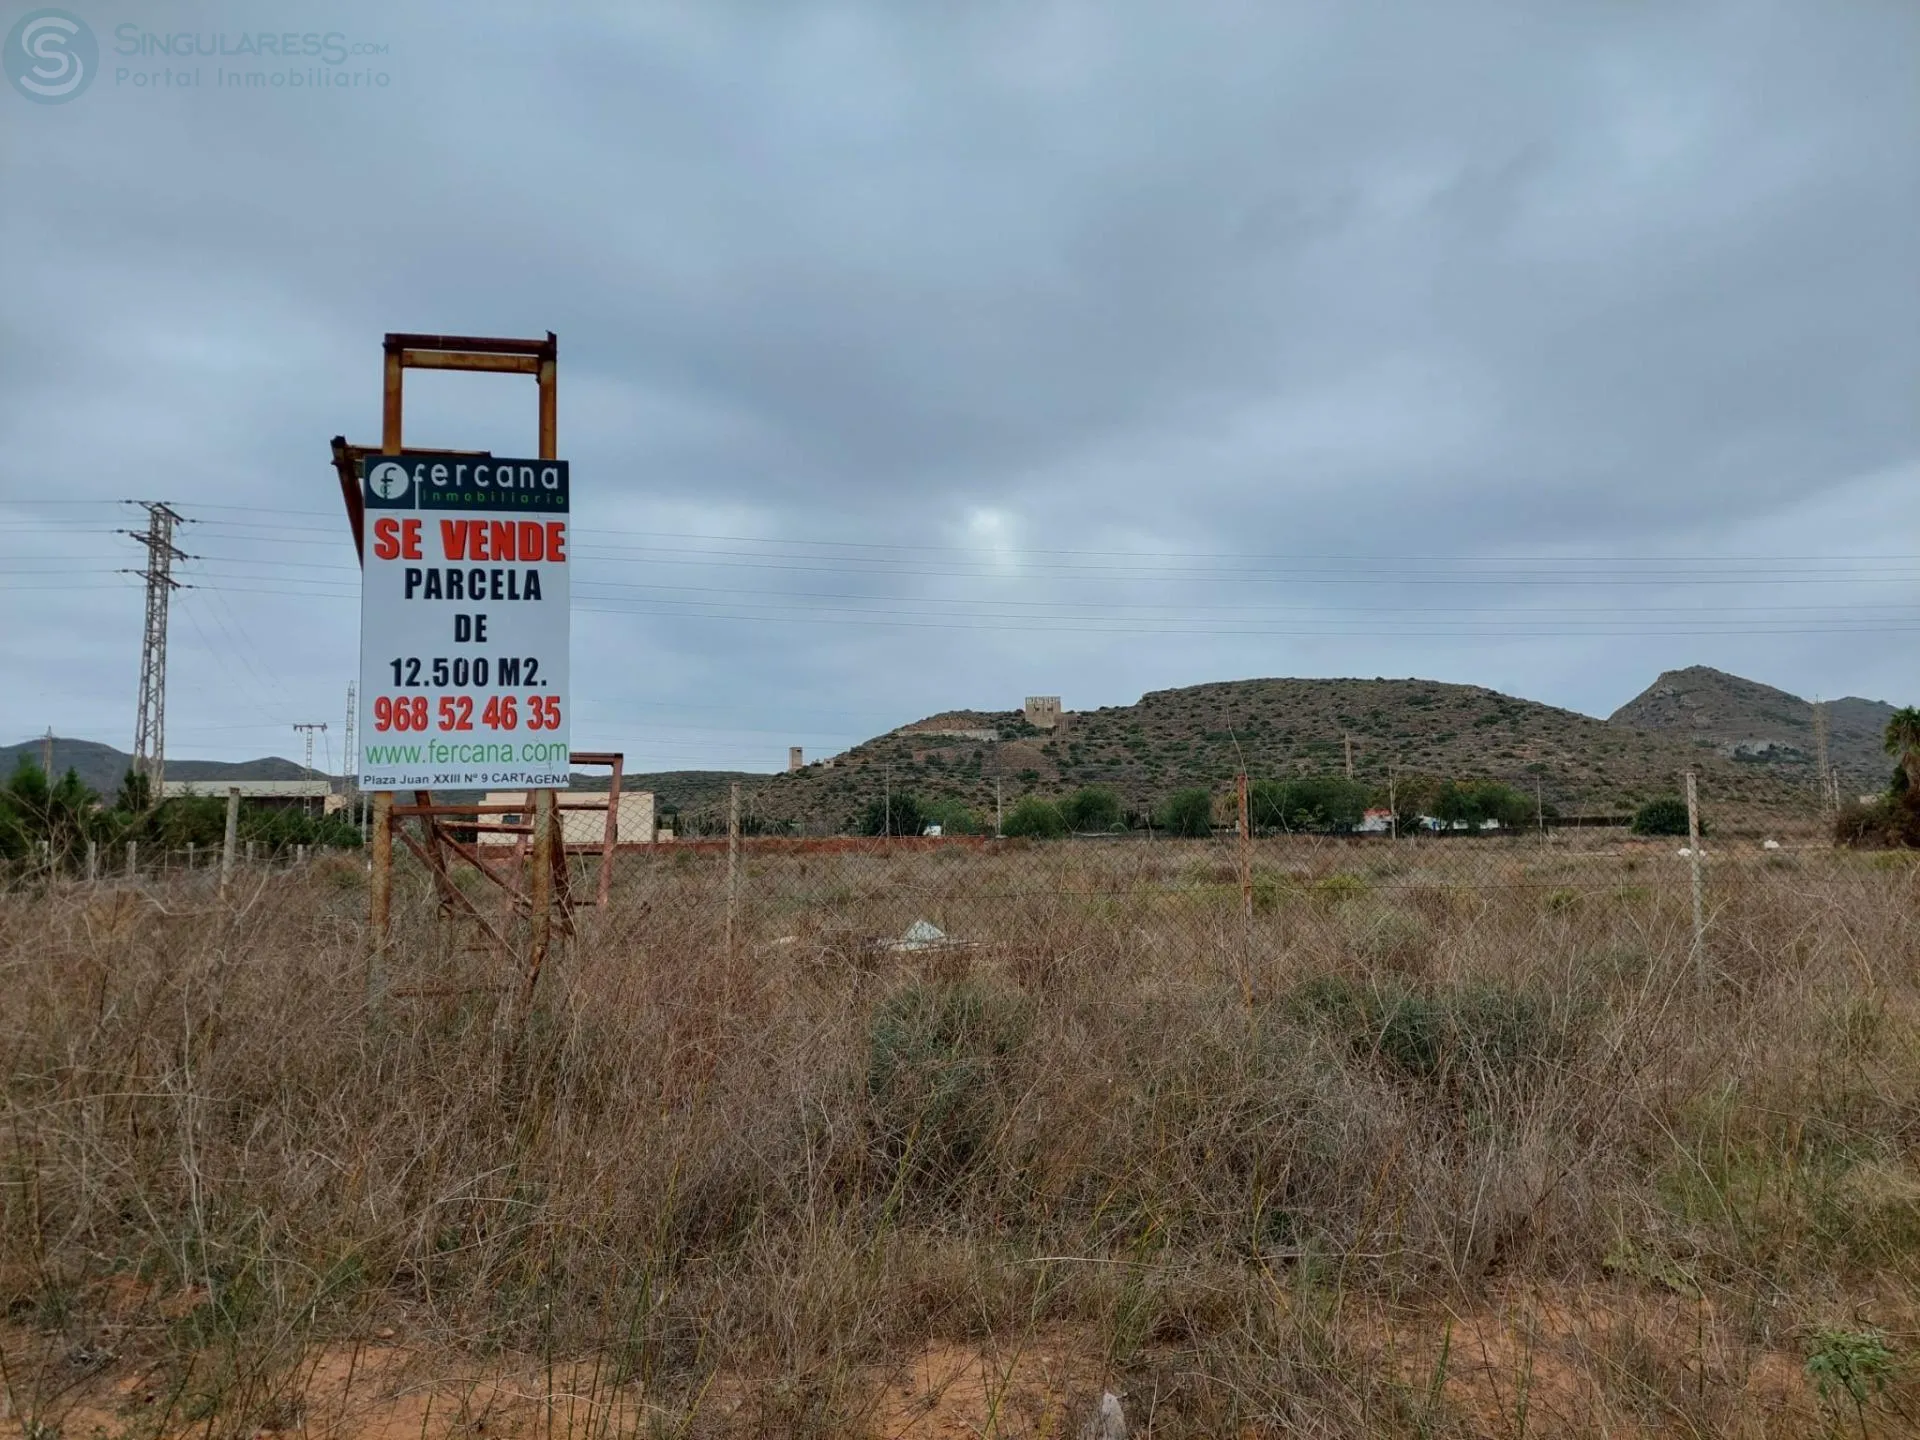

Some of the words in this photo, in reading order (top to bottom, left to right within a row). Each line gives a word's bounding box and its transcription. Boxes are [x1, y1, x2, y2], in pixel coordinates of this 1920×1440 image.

[413, 463, 559, 509] fercana
[374, 517, 423, 561] SE
[440, 519, 567, 562] VENDE
[404, 567, 542, 601] PARCELA
[454, 613, 488, 643] DE
[389, 657, 489, 687] 12.500
[498, 657, 547, 687] M2.
[374, 695, 429, 732] 968
[438, 695, 474, 732] 52
[482, 695, 518, 731] 46
[526, 695, 561, 730] 35
[365, 738, 568, 765] www.fercana.com
[363, 775, 397, 785] Plaza
[400, 775, 430, 785] Juan
[433, 774, 461, 784] XXIII
[481, 773, 489, 783] 9
[491, 773, 570, 784] CARTAGENA
